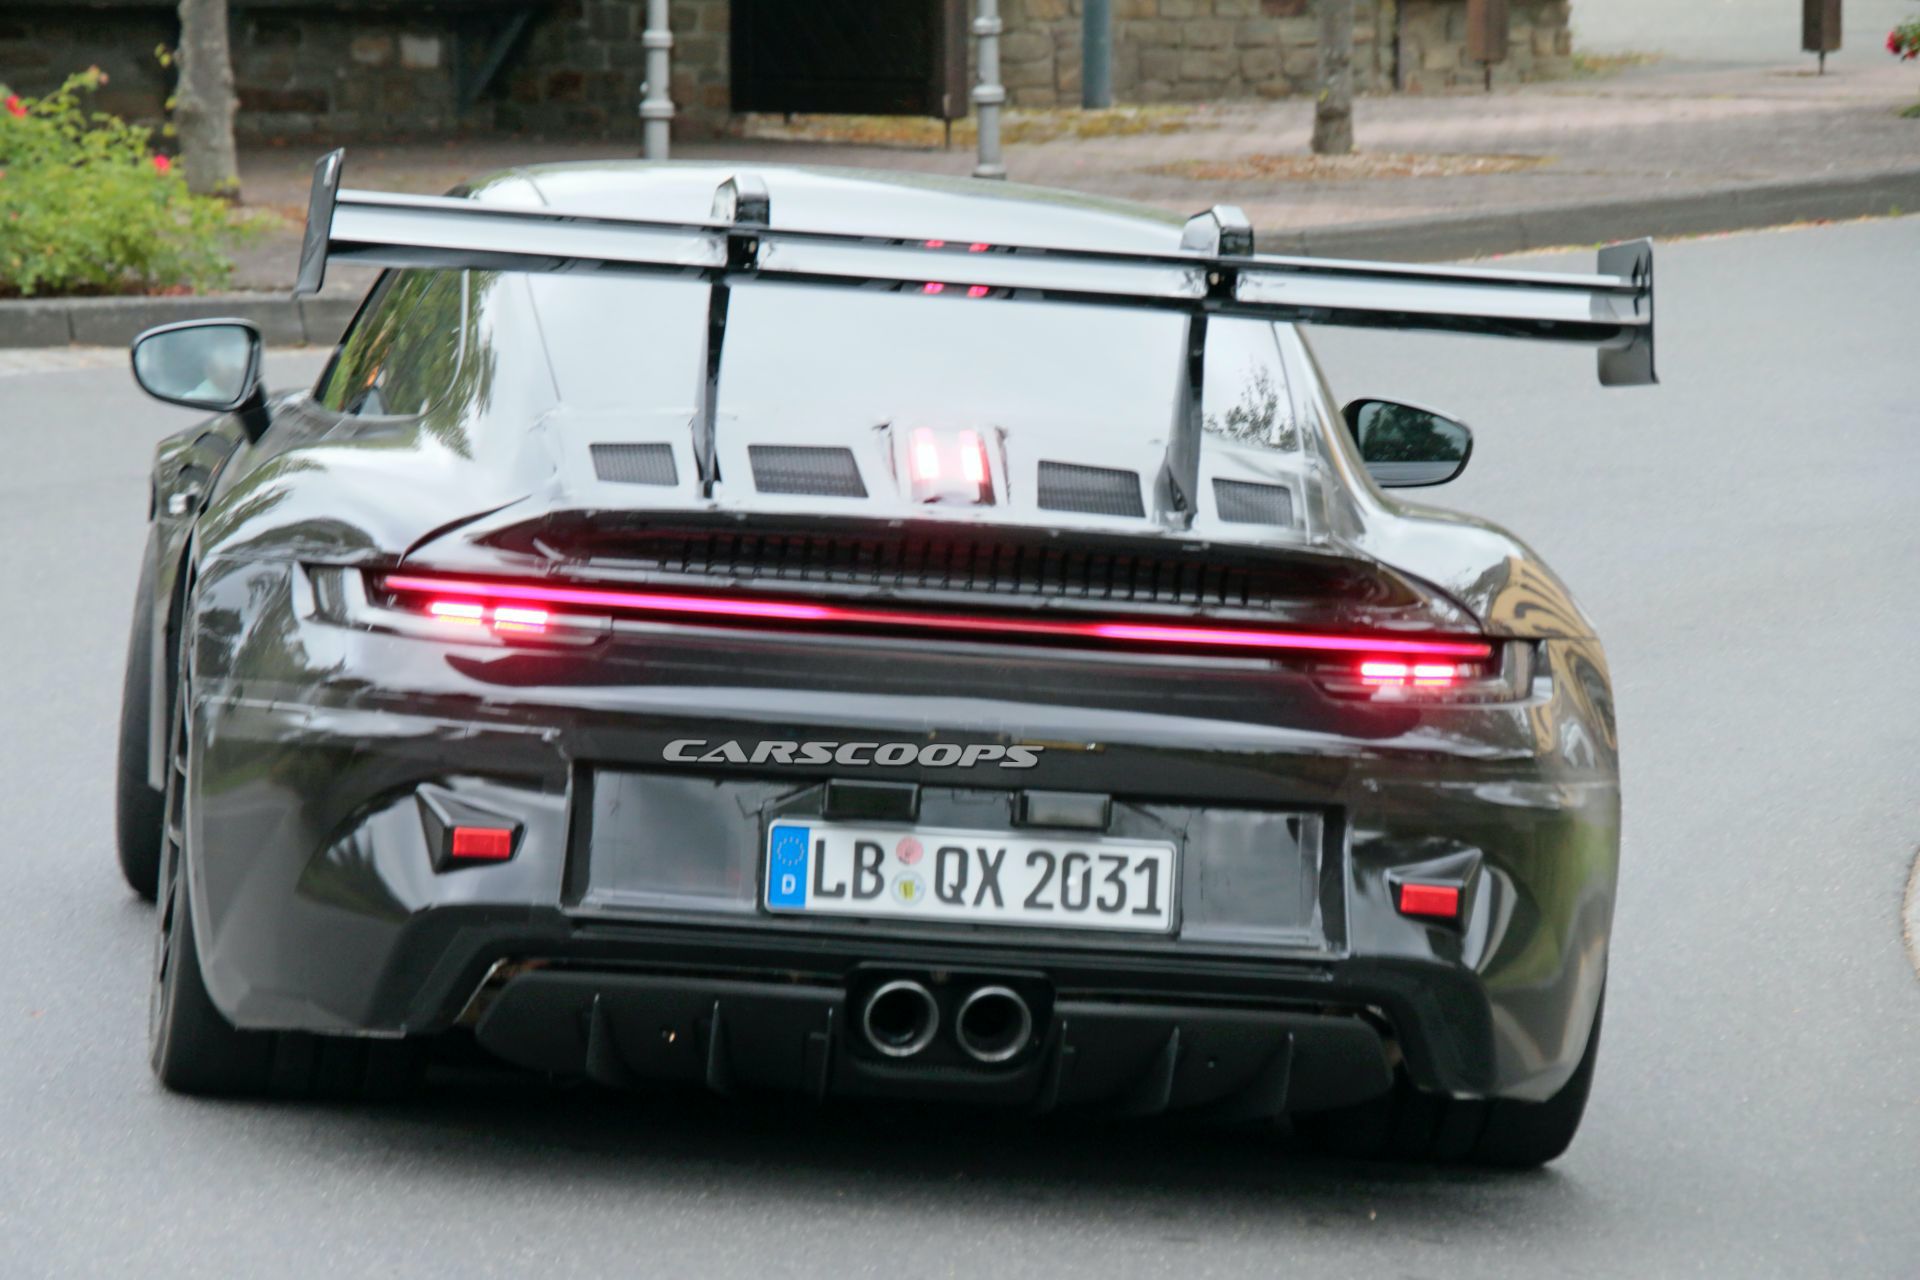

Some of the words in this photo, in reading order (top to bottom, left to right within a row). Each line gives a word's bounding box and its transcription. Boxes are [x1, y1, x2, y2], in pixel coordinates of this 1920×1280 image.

[781, 873, 796, 895] D
[812, 838, 885, 900] LB
[934, 845, 1007, 909] QX
[1023, 849, 1162, 916] 2031
